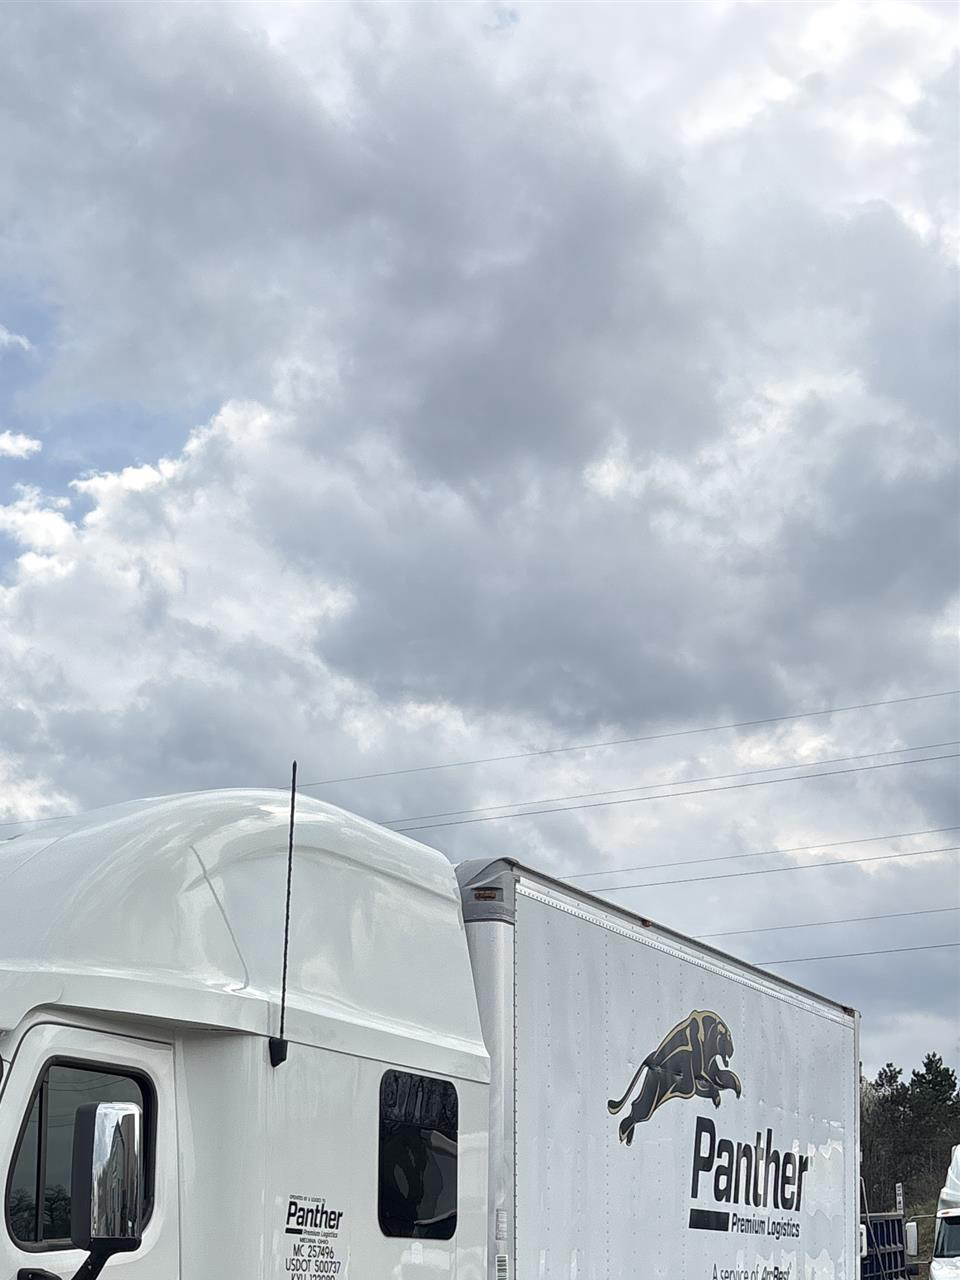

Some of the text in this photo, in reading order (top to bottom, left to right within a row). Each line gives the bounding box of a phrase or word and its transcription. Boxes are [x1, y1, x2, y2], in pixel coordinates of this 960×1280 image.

[691, 1116, 808, 1212] Panther
[286, 1201, 343, 1230] Panther
[731, 1213, 800, 1240] Premium Logistics
[293, 1243, 334, 1259] MC 257496
[285, 1257, 341, 1274] USDOT 500737
